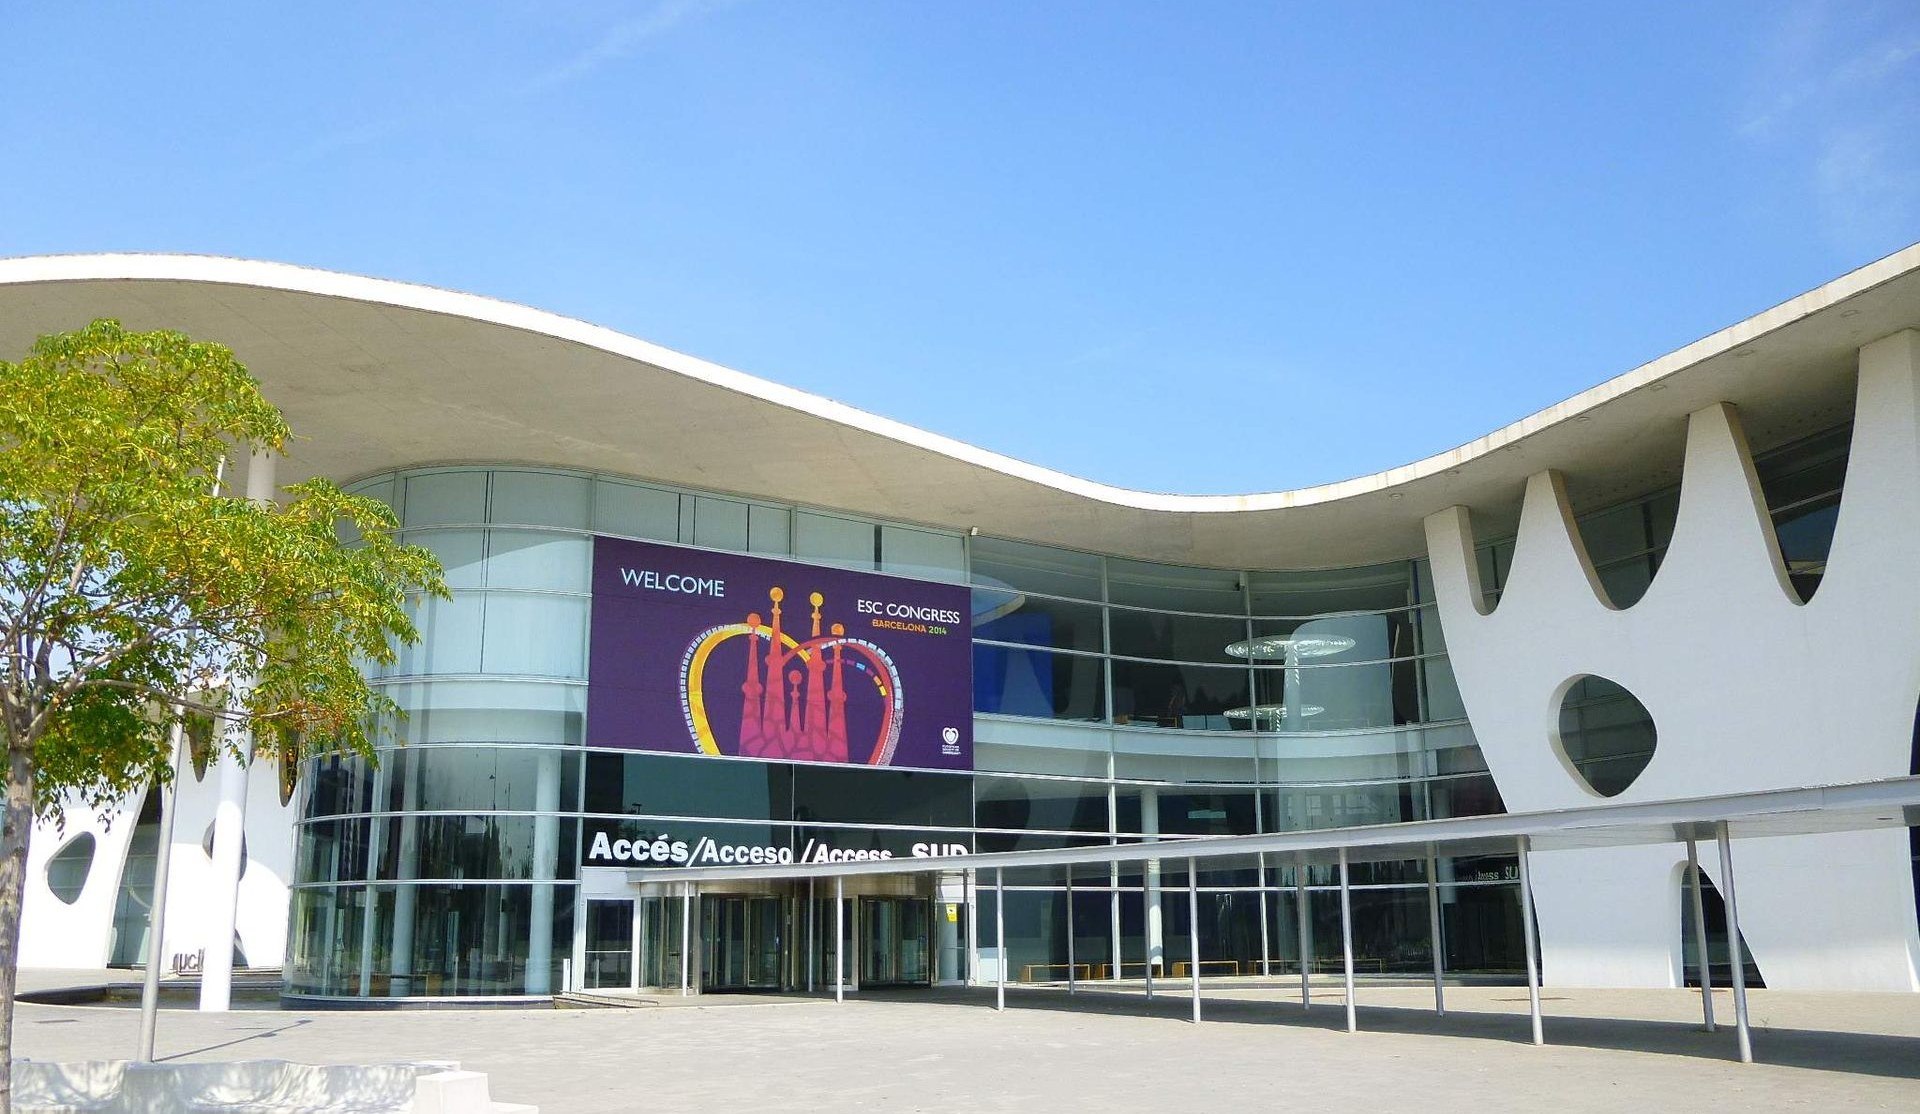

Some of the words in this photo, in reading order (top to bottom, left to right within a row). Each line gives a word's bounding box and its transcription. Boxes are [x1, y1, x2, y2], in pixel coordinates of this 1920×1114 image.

[620, 567, 725, 598] WELCOME
[857, 599, 883, 615] ESC
[886, 603, 961, 624] CONGRESS
[872, 618, 927, 633] BARCELONA
[928, 626, 947, 635] 2014
